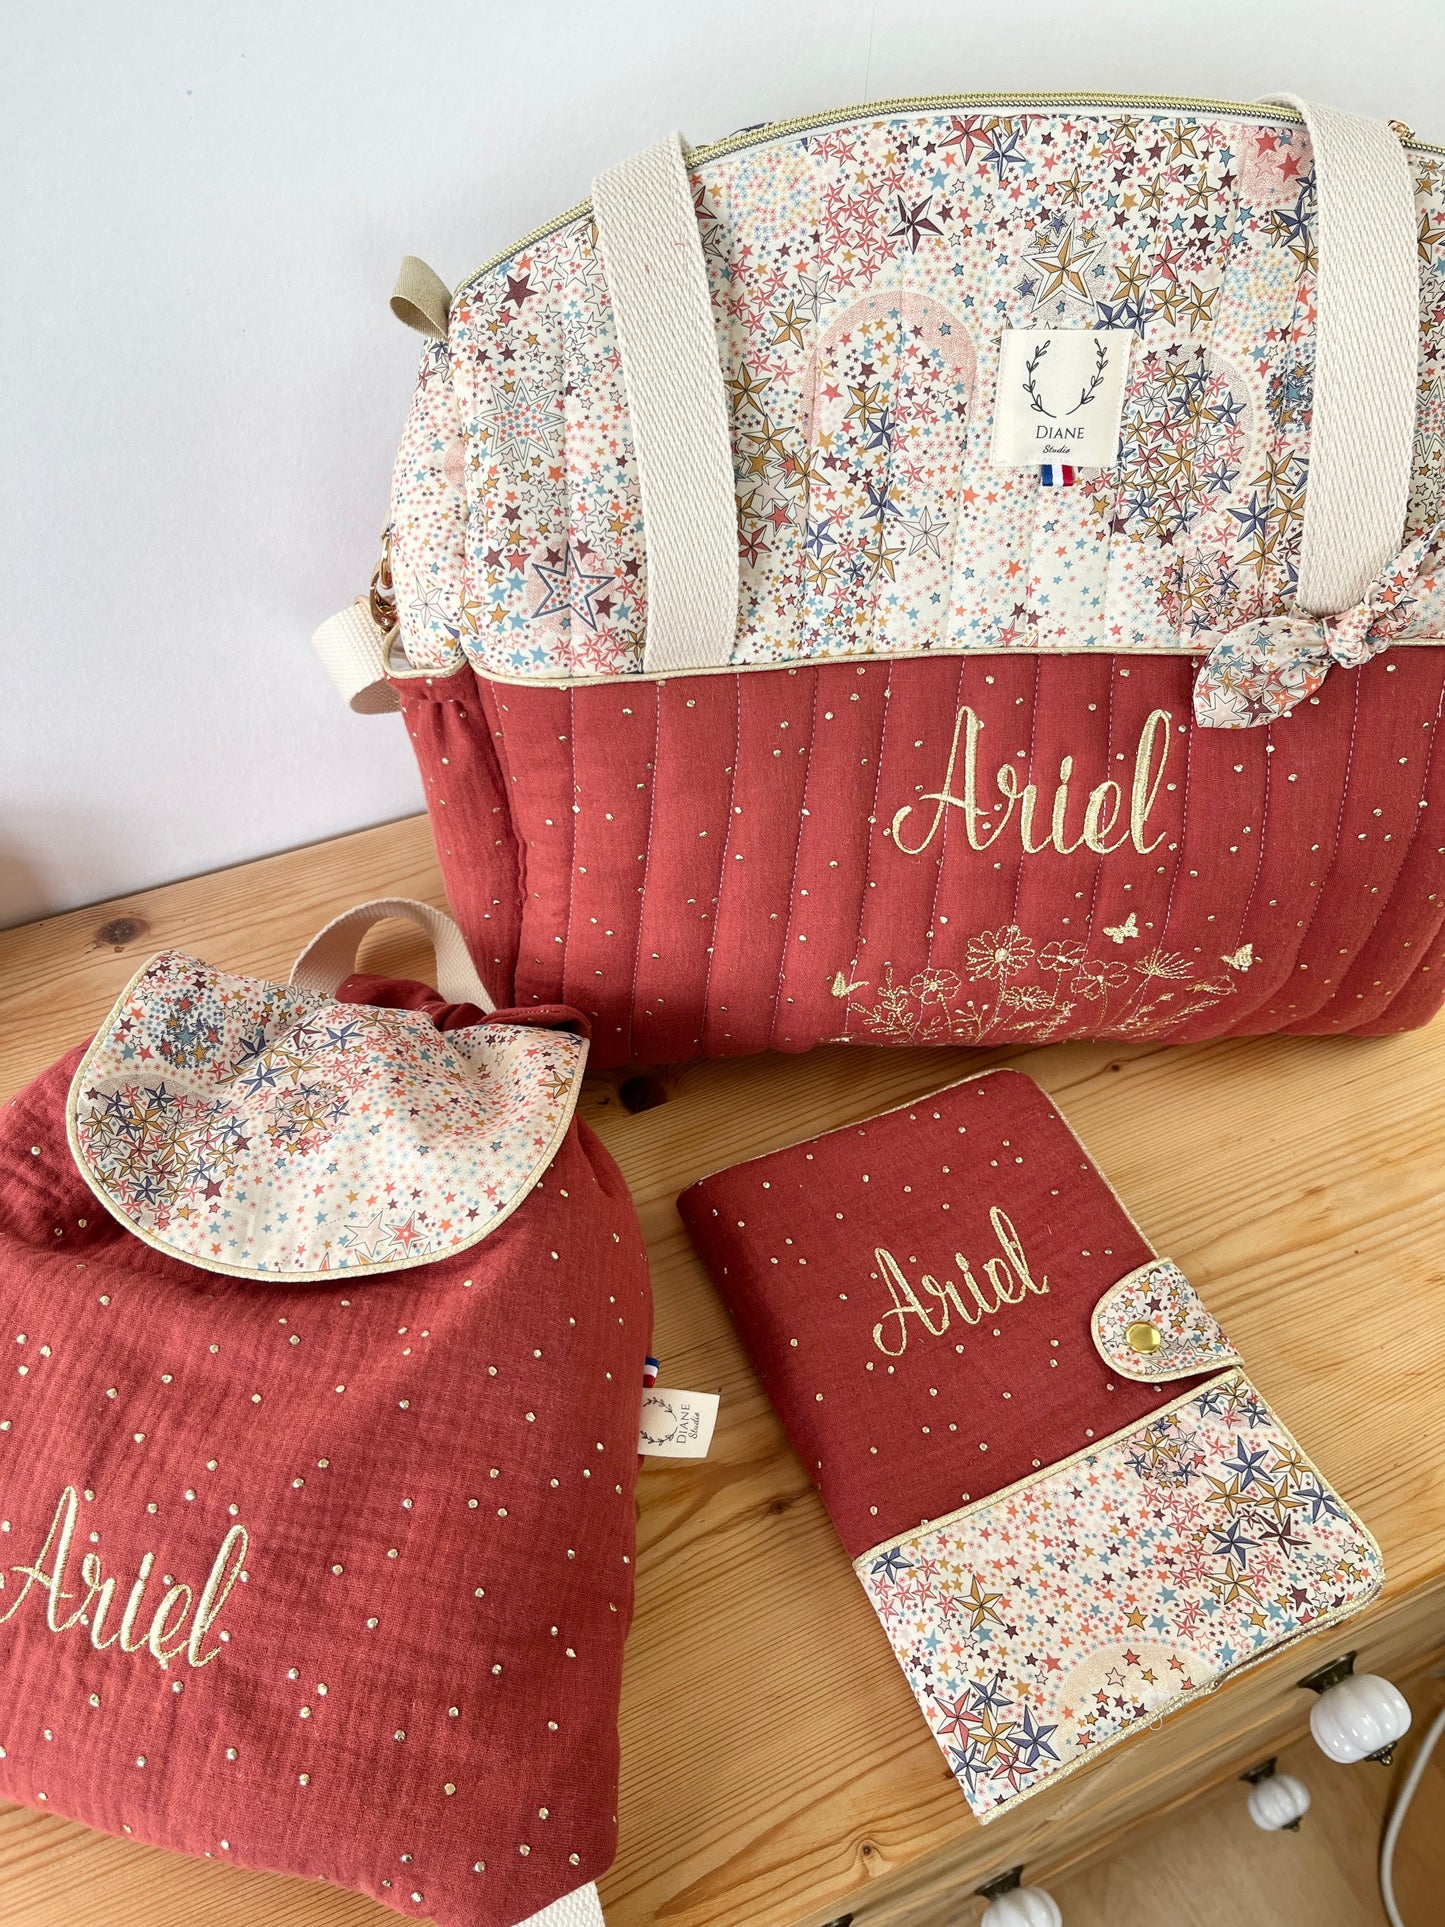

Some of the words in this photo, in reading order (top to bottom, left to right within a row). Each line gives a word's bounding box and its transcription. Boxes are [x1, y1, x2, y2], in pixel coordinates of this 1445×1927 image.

[1036, 425, 1085, 438] DIANE
[1043, 444, 1070, 453] Studio
[892, 705, 1170, 855] Ariel
[872, 1206, 1050, 1356] Ariel
[676, 1404, 690, 1443] DIANE
[688, 1412, 700, 1439] Studio
[0, 1485, 249, 1668] Ariel
